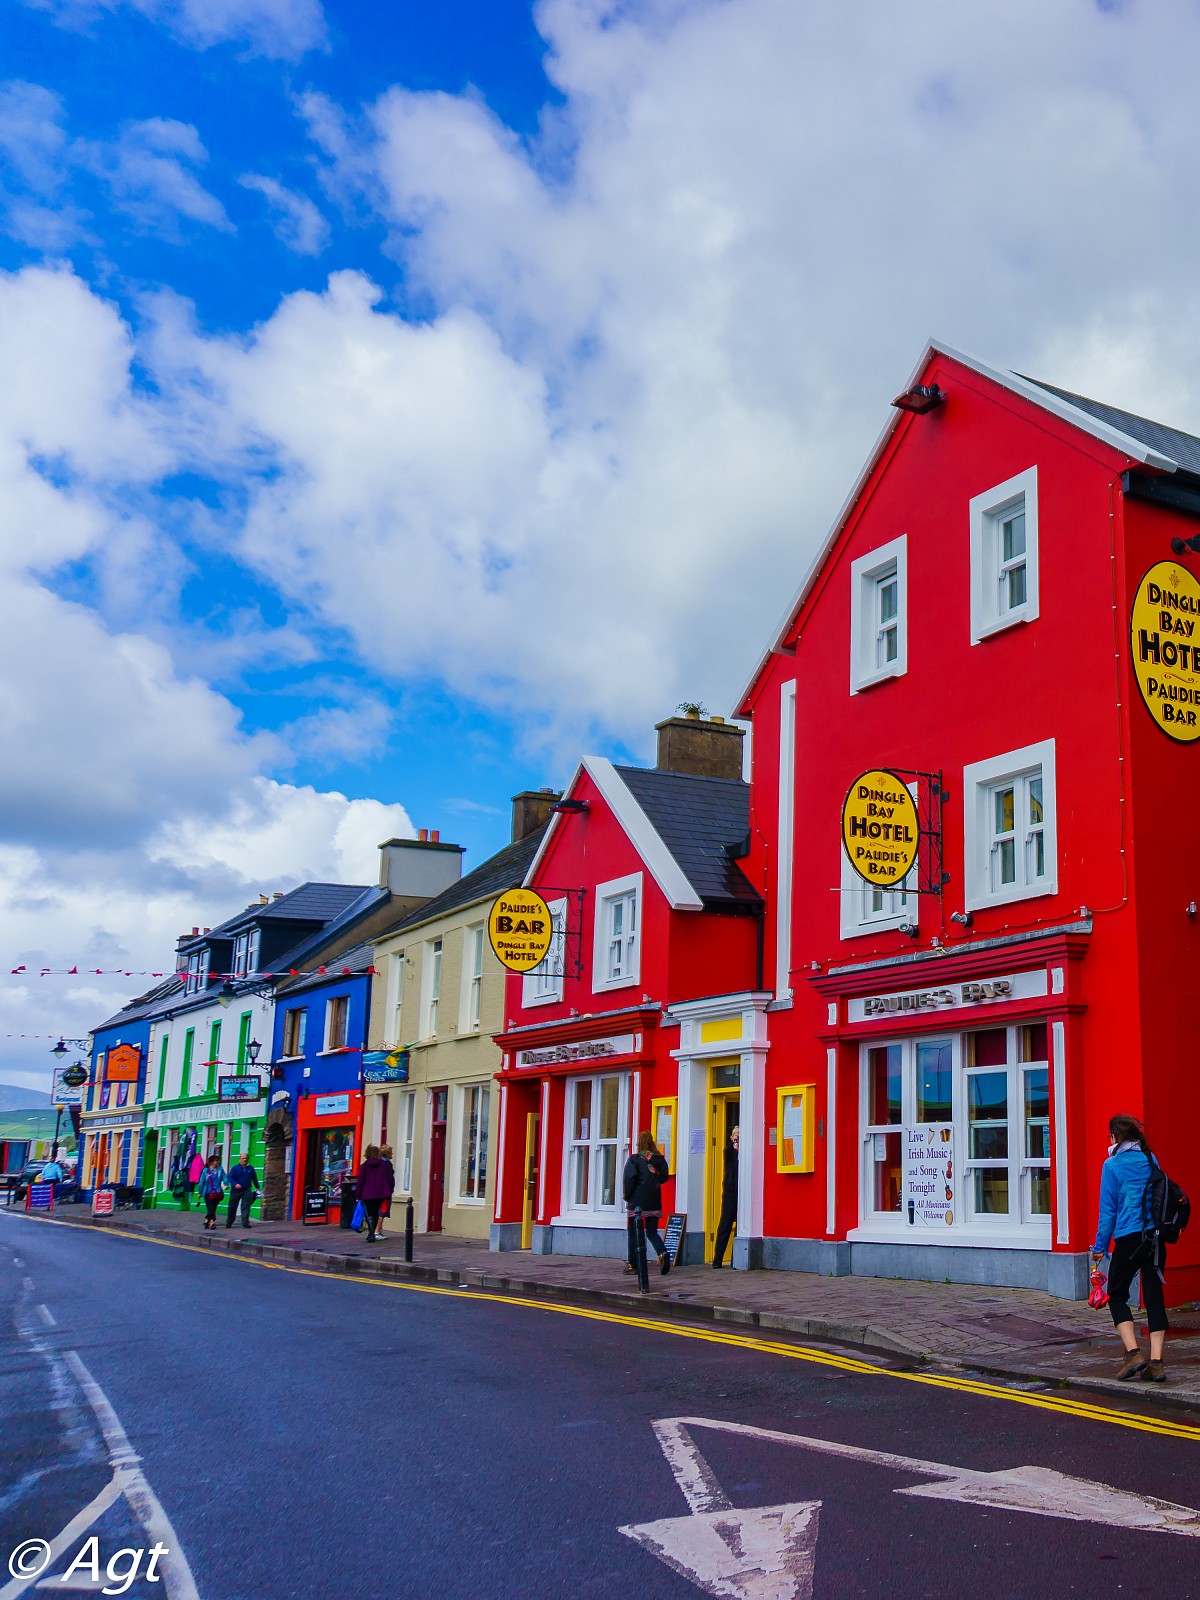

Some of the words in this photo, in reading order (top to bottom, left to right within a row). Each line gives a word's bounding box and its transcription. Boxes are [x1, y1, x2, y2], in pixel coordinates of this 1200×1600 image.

[1159, 611, 1195, 637] BAY
[1162, 704, 1197, 727] BAR
[858, 786, 906, 805] DINGLE
[867, 803, 894, 819] BAY
[849, 816, 913, 843] HOTEL
[855, 847, 908, 863] PAUDIE'S
[868, 862, 896, 876] BAR
[500, 902, 542, 914] PAUDIE'S
[496, 916, 545, 935] BAR
[497, 941, 526, 949] DINGLE
[529, 942, 545, 950] BAY
[504, 951, 537, 961] HOTEL
[961, 981, 1013, 1003] BAR
[908, 1130, 924, 1143] Live
[908, 1148, 924, 1159] Irish
[926, 1147, 948, 1159] Music
[908, 1167, 918, 1176] and
[919, 1165, 938, 1179] Song
[908, 1181, 936, 1196] Tonight
[916, 1200, 924, 1208] All
